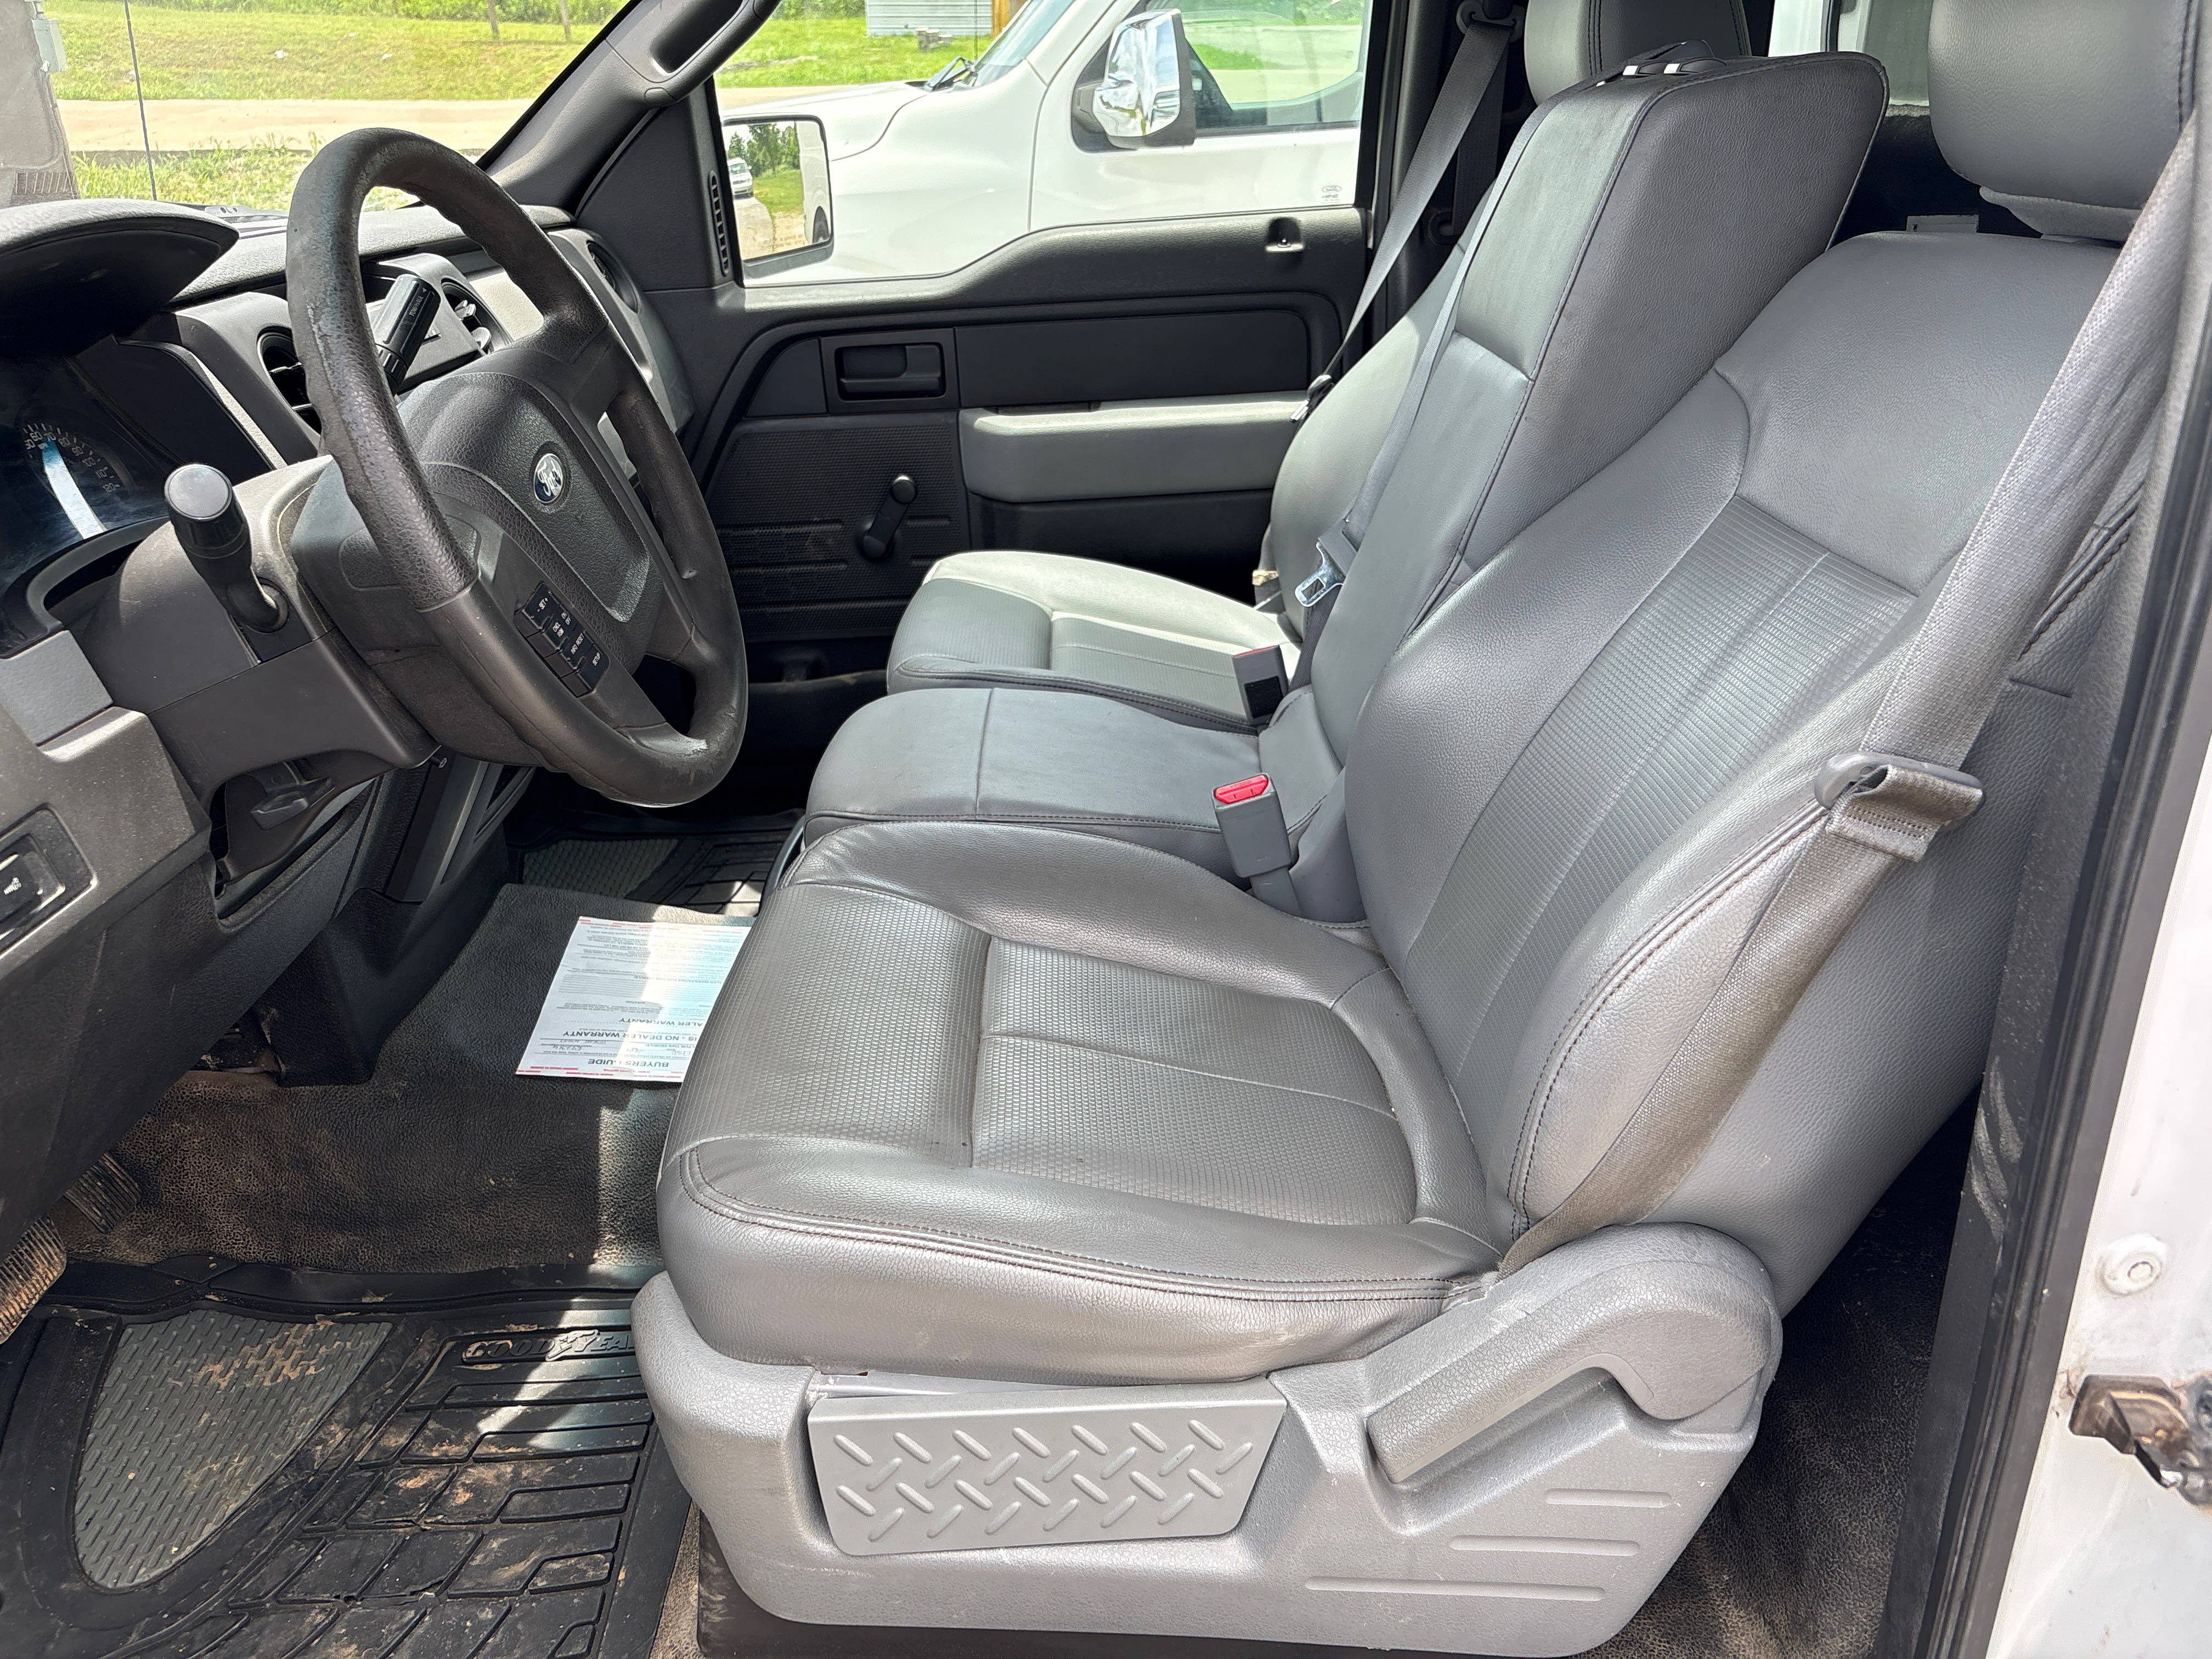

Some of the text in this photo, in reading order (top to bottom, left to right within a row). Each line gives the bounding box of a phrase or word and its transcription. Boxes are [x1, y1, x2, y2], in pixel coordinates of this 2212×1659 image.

[409, 295, 424, 317] TOW/HAUL
[30, 431, 43, 441] 60
[43, 432, 56, 442] 70
[58, 437, 70, 447] 80
[71, 446, 83, 456] 90
[82, 457, 96, 466] 100
[536, 456, 563, 500] Ford
[103, 482, 116, 492] 120
[592, 652, 601, 666] SETUP
[467, 1333, 636, 1358] GOODYEA
